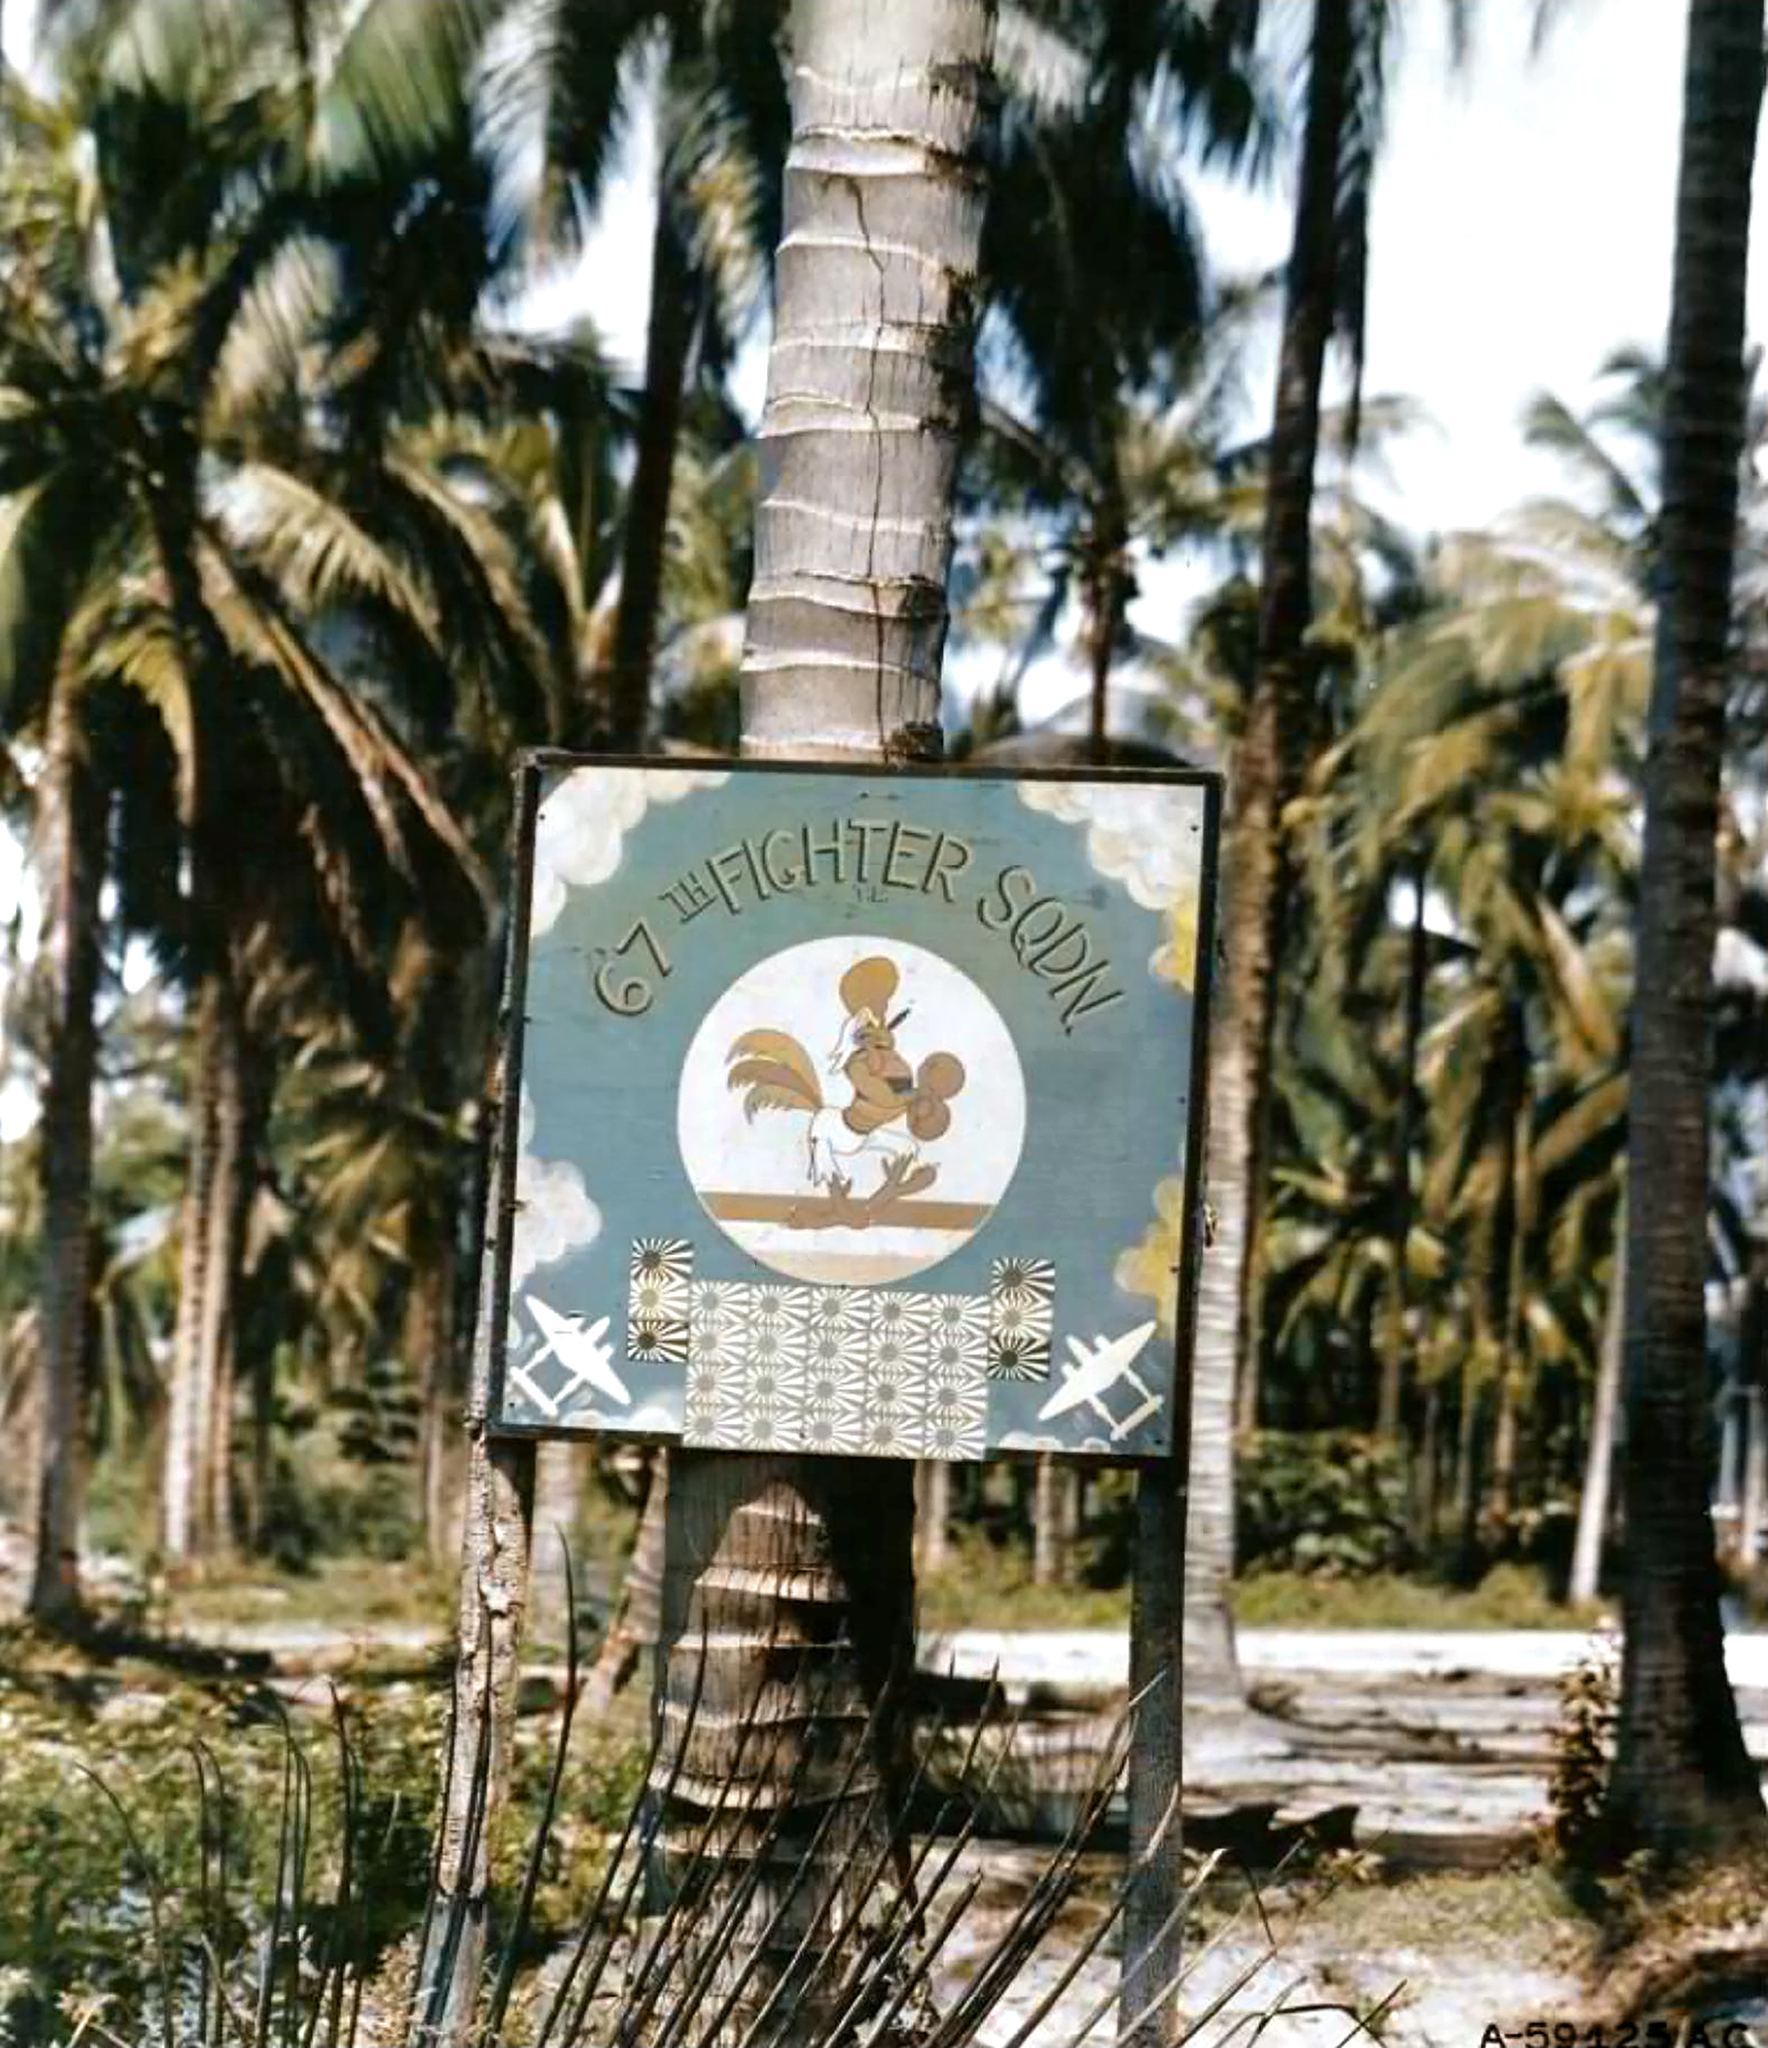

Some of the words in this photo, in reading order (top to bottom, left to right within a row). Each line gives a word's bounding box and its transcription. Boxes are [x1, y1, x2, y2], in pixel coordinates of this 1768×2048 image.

[594, 917, 673, 1016] 67
[704, 817, 974, 916] FIGHTER
[977, 864, 1126, 1036] SQDN
